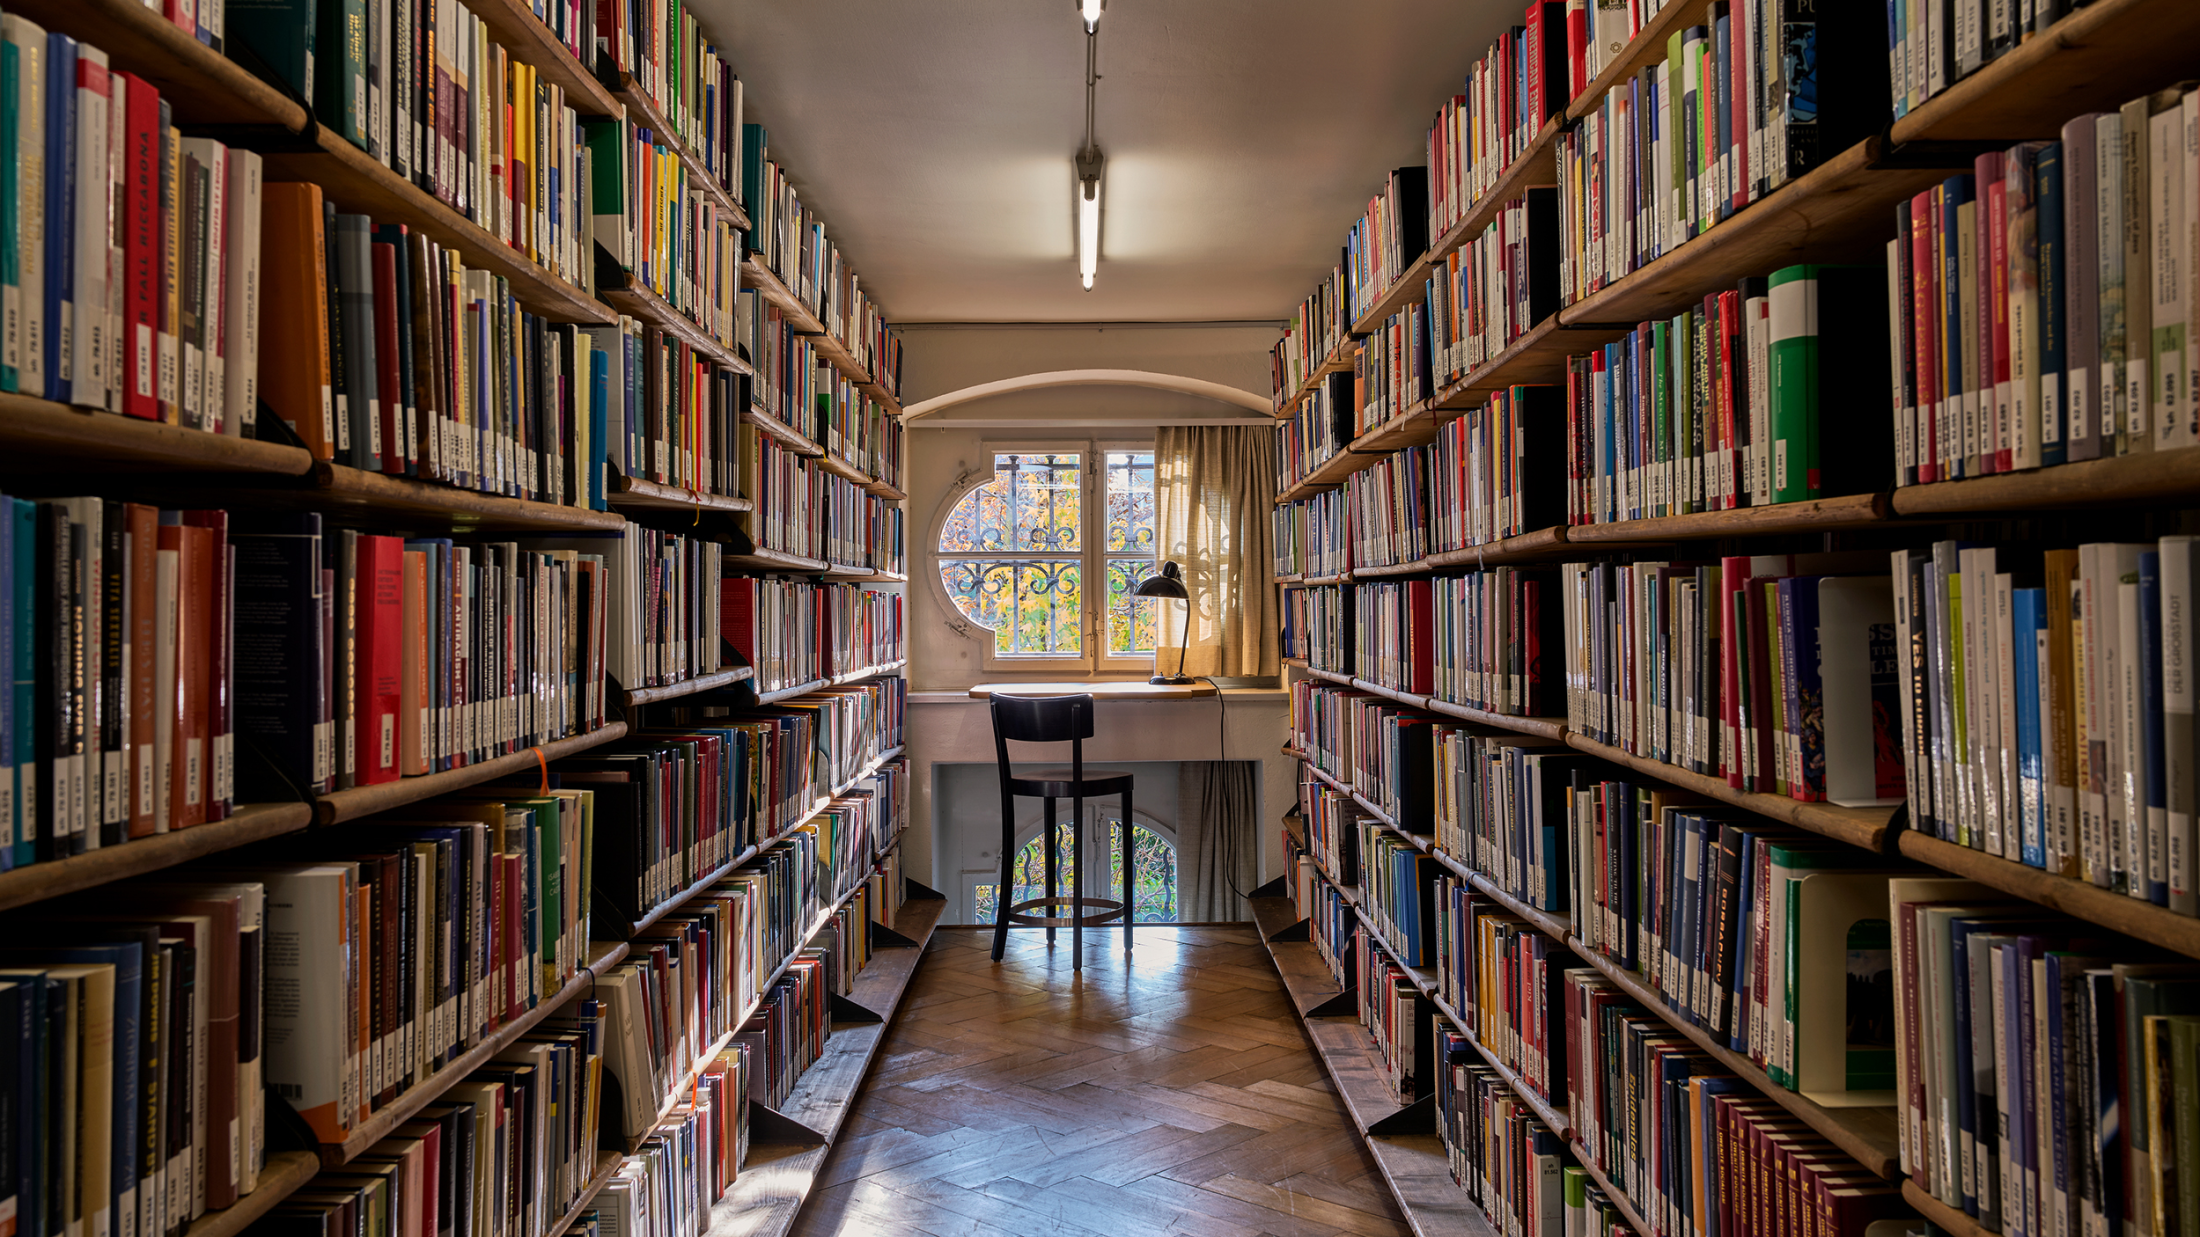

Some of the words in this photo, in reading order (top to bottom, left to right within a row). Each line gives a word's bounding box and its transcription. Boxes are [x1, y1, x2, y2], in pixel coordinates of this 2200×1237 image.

[139, 131, 151, 246] RICCABONA
[139, 256, 150, 300] FALL
[454, 605, 462, 680] ANTIRACISM
[1911, 630, 1925, 668] YES
[1914, 671, 1926, 694] TO
[2170, 669, 2183, 694] DER
[150, 953, 160, 978] JIM
[149, 982, 159, 1043] DOWNS
[146, 1082, 158, 1149] STAND
